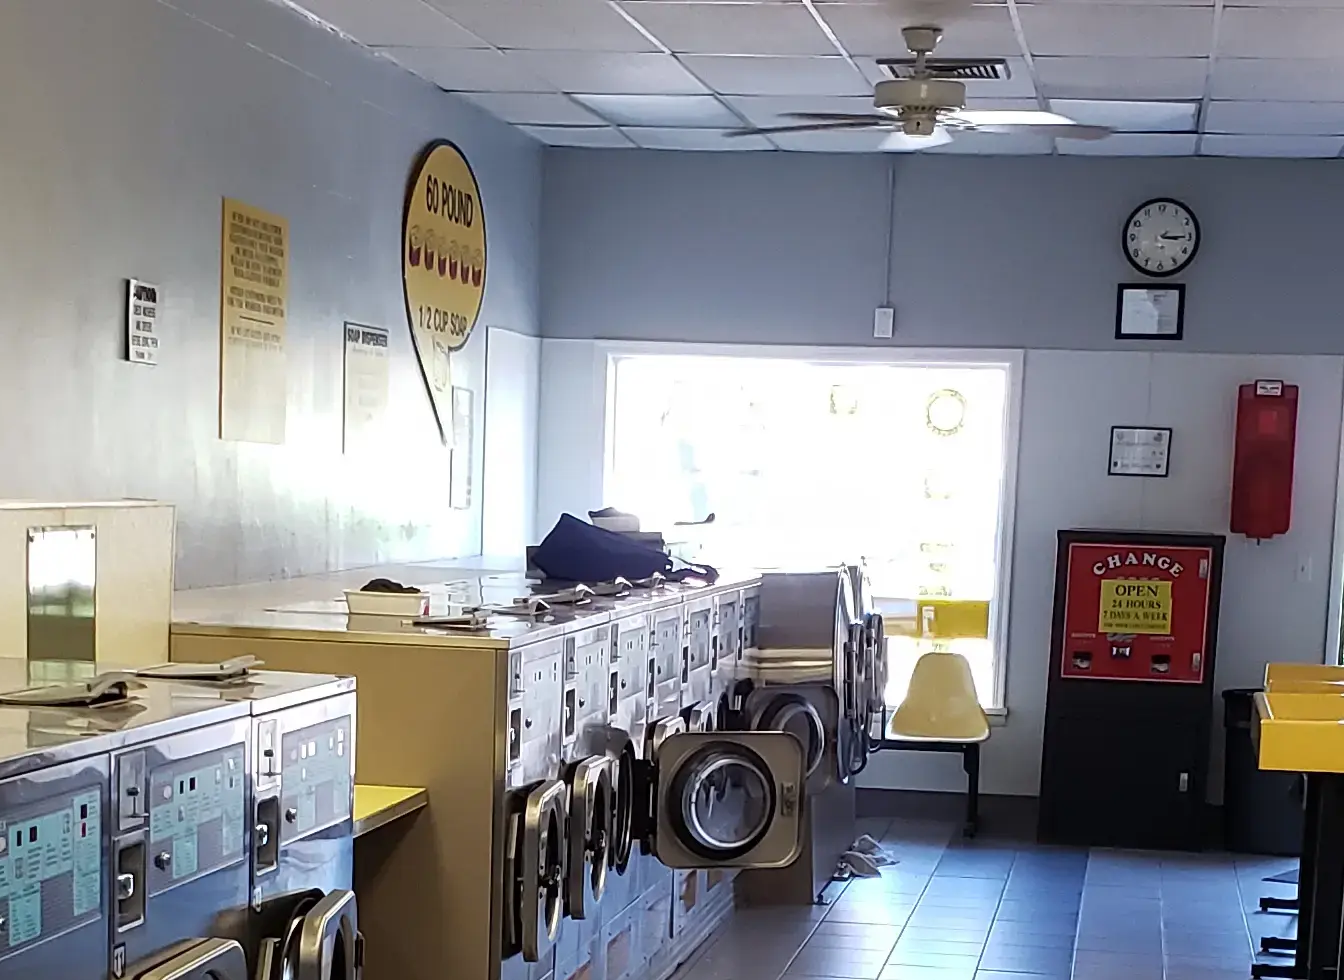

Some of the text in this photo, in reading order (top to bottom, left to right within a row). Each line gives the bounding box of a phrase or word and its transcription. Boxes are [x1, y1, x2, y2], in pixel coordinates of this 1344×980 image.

[426, 174, 473, 228] 60 POUND
[434, 309, 448, 333] CUP
[450, 312, 468, 337] SOAP
[348, 328, 360, 342] SOAP
[1093, 552, 1183, 577] CHANGE
[1115, 584, 1159, 597] OPEN
[1112, 600, 1161, 609] 24 HOURS
[1142, 612, 1168, 621] WEEK
